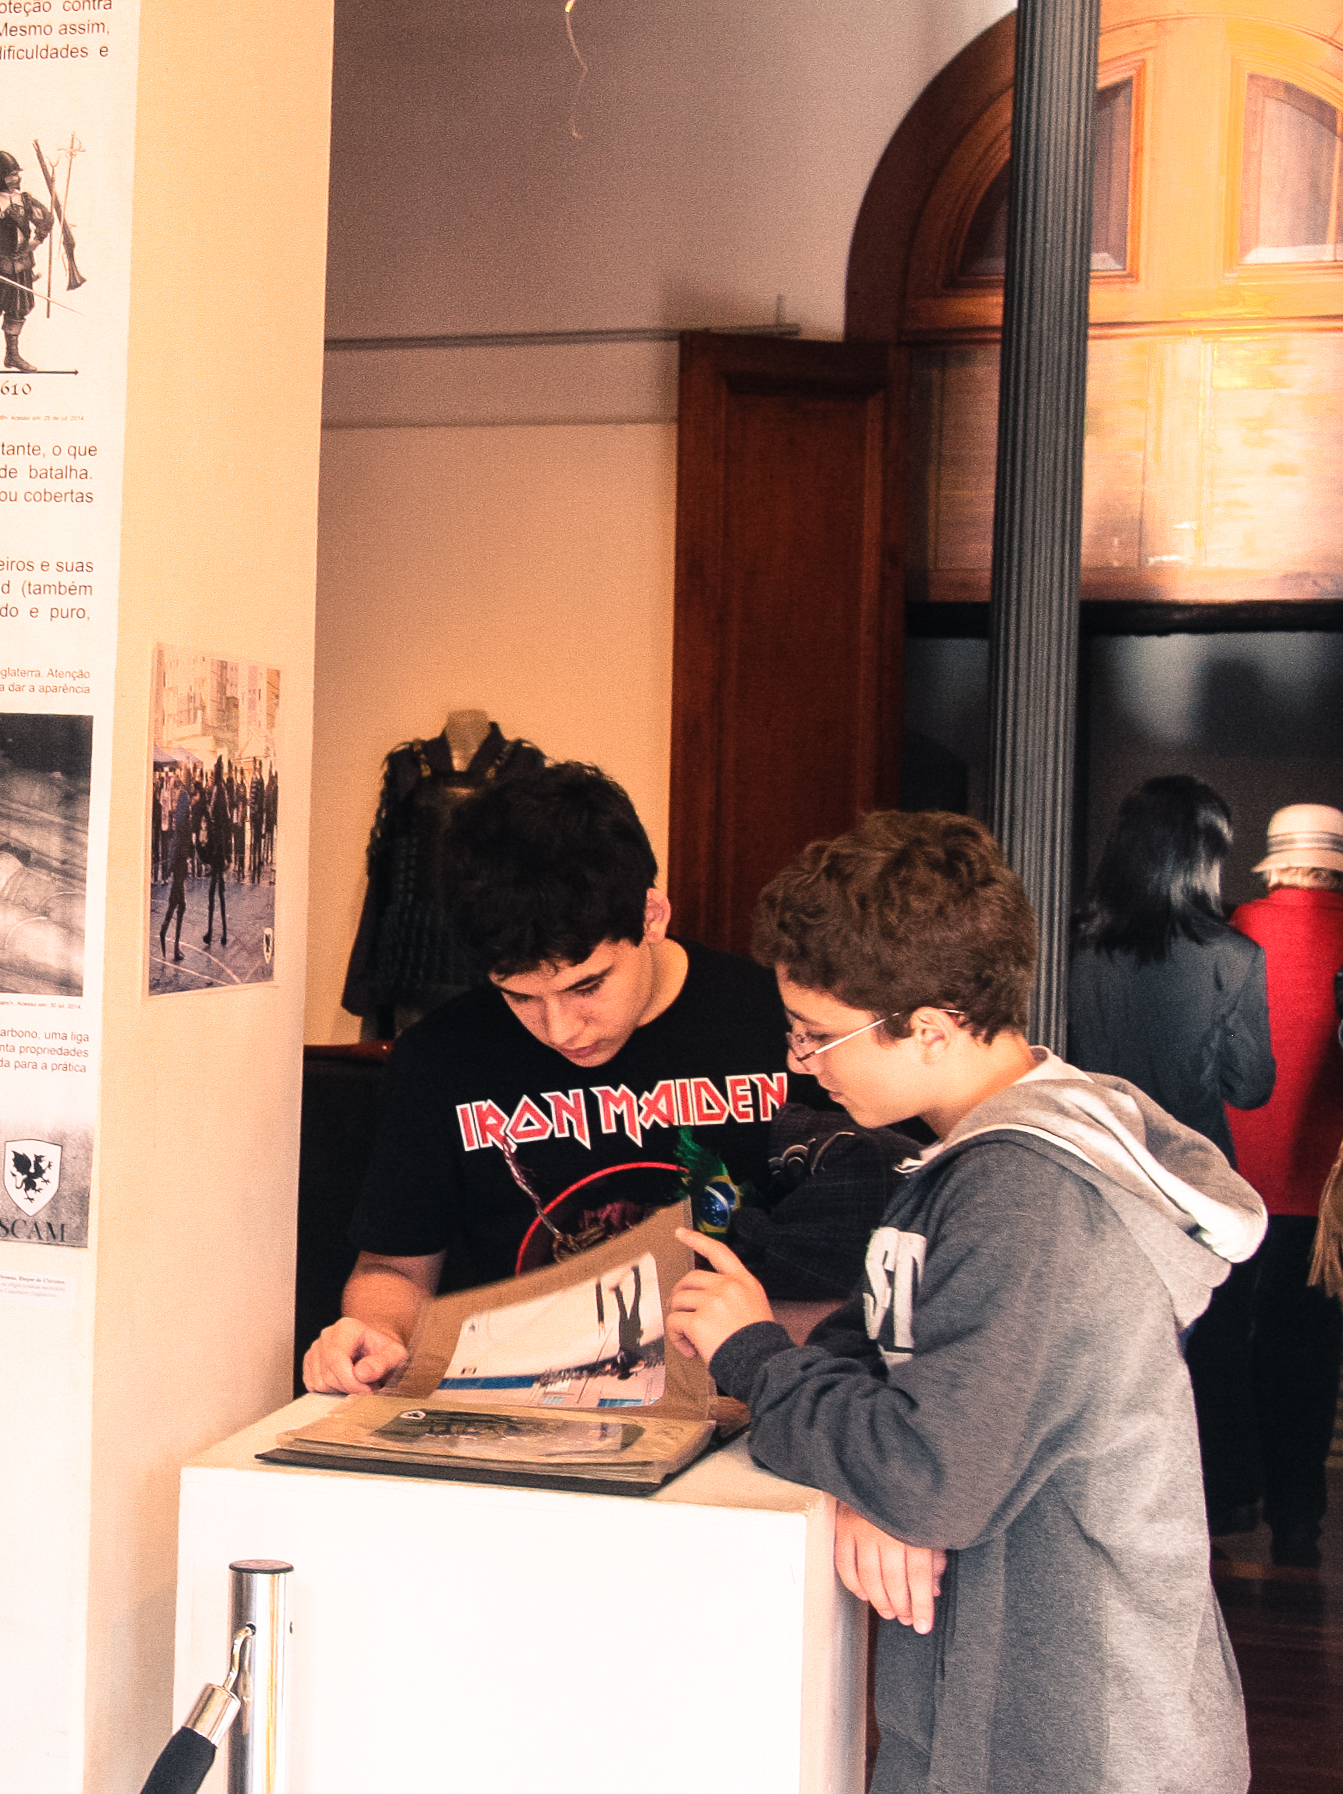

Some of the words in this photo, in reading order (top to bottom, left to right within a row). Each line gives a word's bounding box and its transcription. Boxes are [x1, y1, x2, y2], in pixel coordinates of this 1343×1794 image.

[62, 0, 112, 12] contra
[58, 19, 110, 36] assim,
[67, 444, 98, 460] que
[28, 464, 93, 480] batalha.
[23, 488, 94, 504] cobertas
[55, 561, 94, 573] suas
[50, 607, 90, 622] puro,
[46, 668, 91, 682] Atenção
[18, 1045, 89, 1058] propriedades
[456, 1088, 591, 1153] IRON
[590, 1072, 788, 1149] MAIDEN
